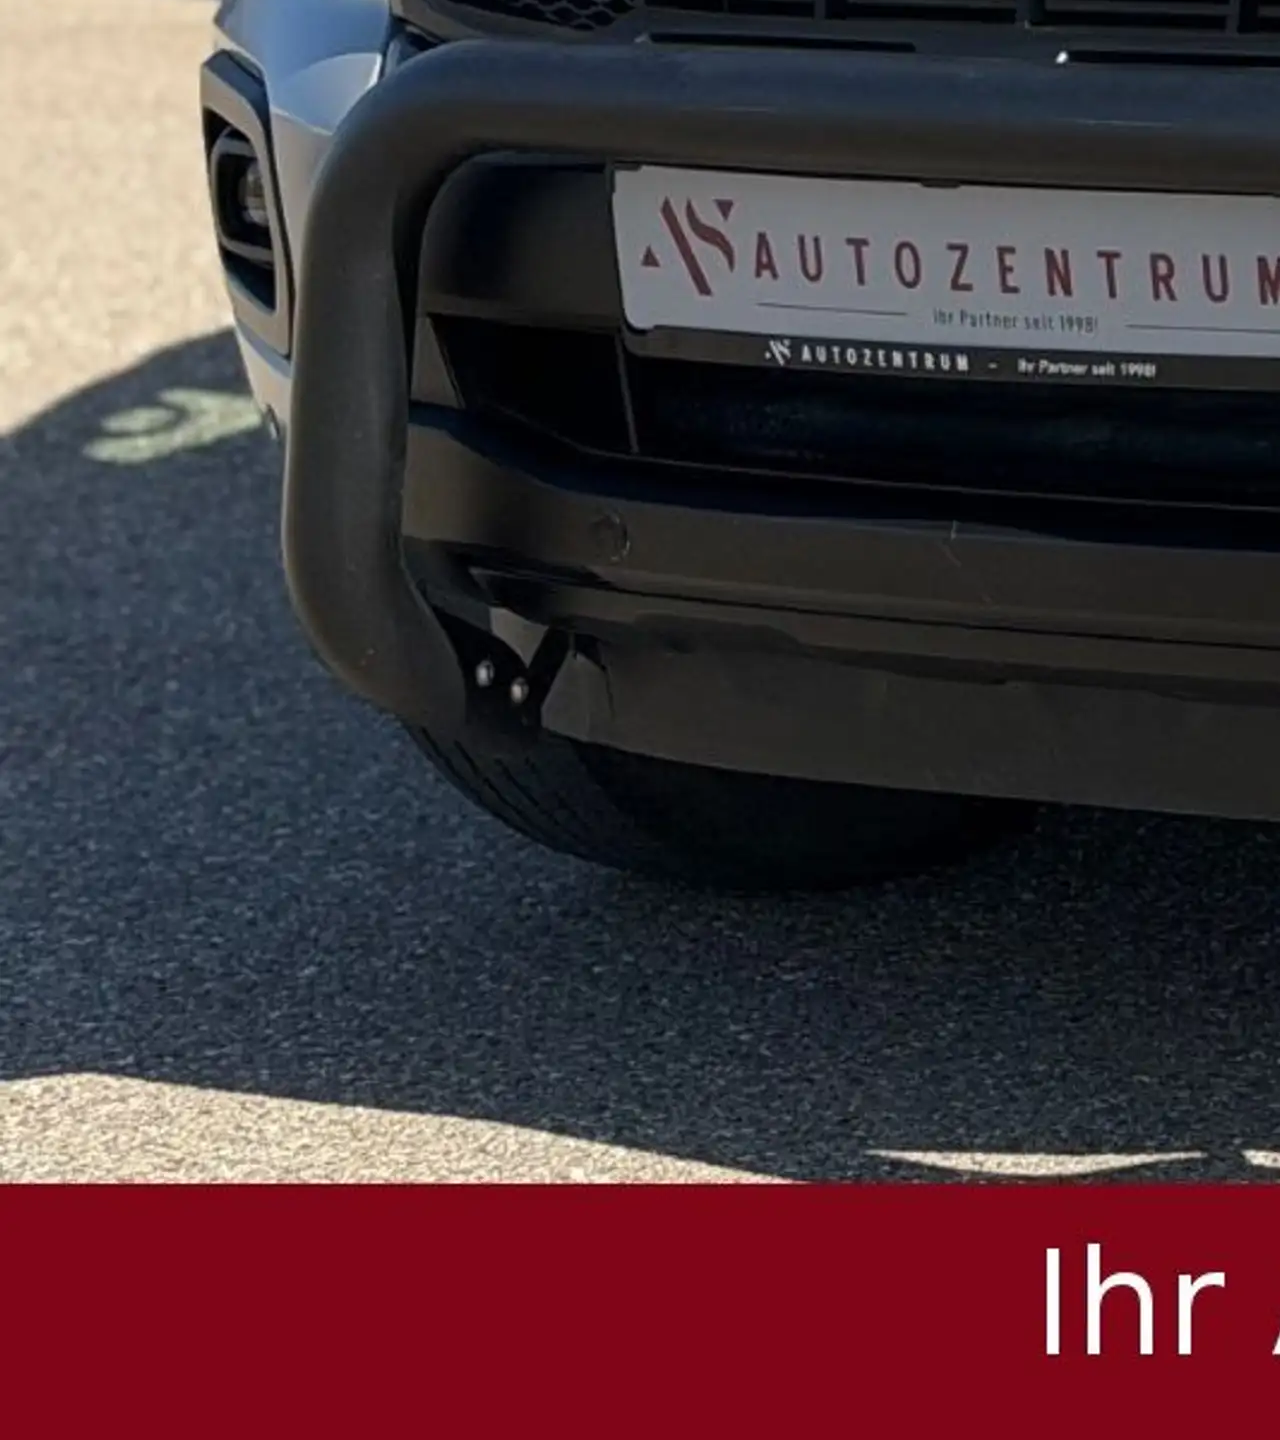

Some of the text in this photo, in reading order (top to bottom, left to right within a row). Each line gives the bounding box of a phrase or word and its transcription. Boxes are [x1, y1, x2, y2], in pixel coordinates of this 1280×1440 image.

[960, 308, 1018, 330] Partner
[1024, 312, 1054, 331] seit
[801, 344, 969, 371] AUTOZENTRUM
[1038, 359, 1089, 376] Partner
[1091, 361, 1116, 377] seit
